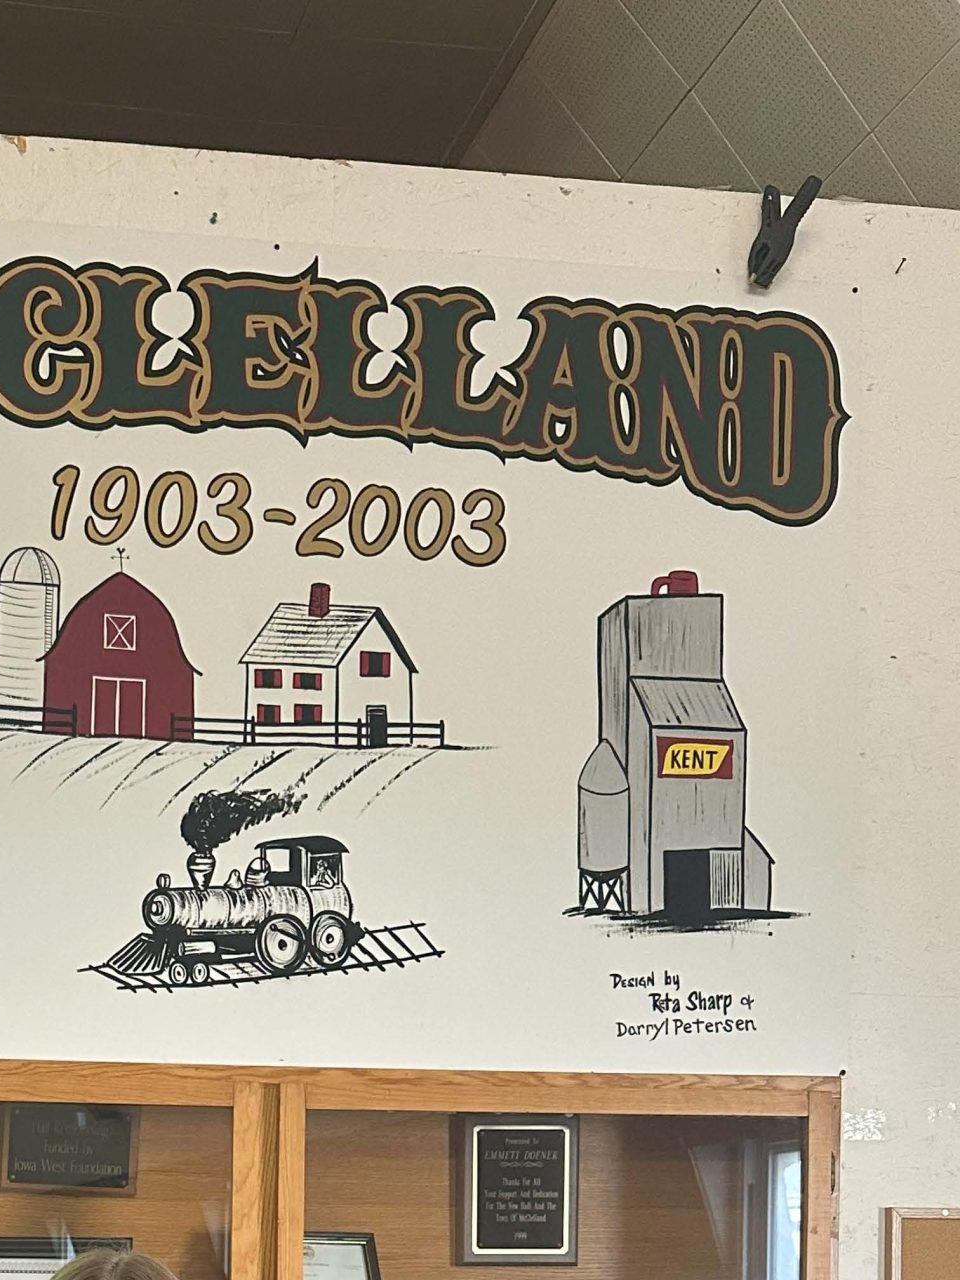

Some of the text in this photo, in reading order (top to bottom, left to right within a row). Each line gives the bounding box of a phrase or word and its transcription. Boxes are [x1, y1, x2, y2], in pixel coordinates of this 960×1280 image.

[50, 464, 506, 567] 1903-2003
[671, 750, 718, 769] KENT
[664, 970, 680, 991] by
[685, 991, 733, 1015] Sharp
[616, 1018, 757, 1041] Darryl Petersen
[14, 1157, 37, 1172] Iowa
